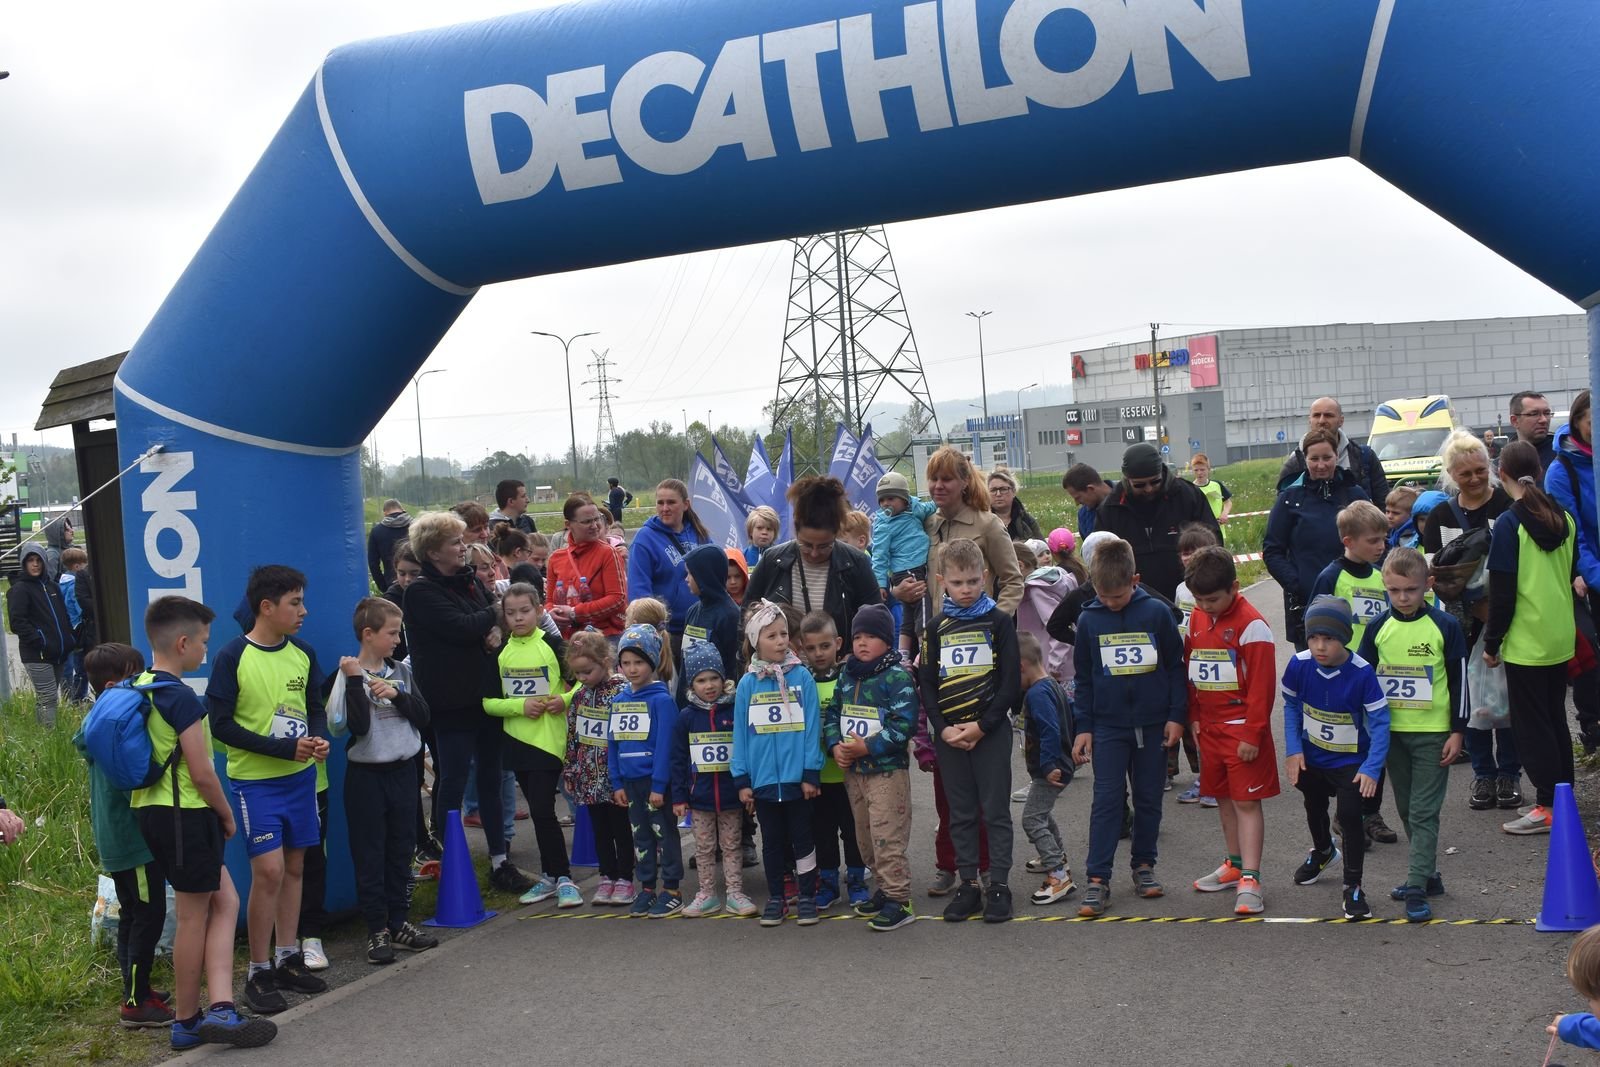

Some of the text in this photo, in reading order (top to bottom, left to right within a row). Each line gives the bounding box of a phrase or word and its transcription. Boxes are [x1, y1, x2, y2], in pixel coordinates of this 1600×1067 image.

[464, 0, 1252, 205] DECATHLON
[1364, 599, 1382, 616] 29
[951, 646, 978, 665] 67
[1114, 646, 1143, 665] 53
[1198, 663, 1220, 681] 51
[512, 679, 537, 695] 22
[1385, 678, 1416, 698] 25
[618, 714, 639, 732] 58
[767, 705, 782, 723] 8
[284, 720, 307, 738] 32
[583, 719, 603, 737] 14
[846, 718, 869, 738] 20
[1320, 724, 1334, 742] 5
[701, 745, 729, 763] 68
